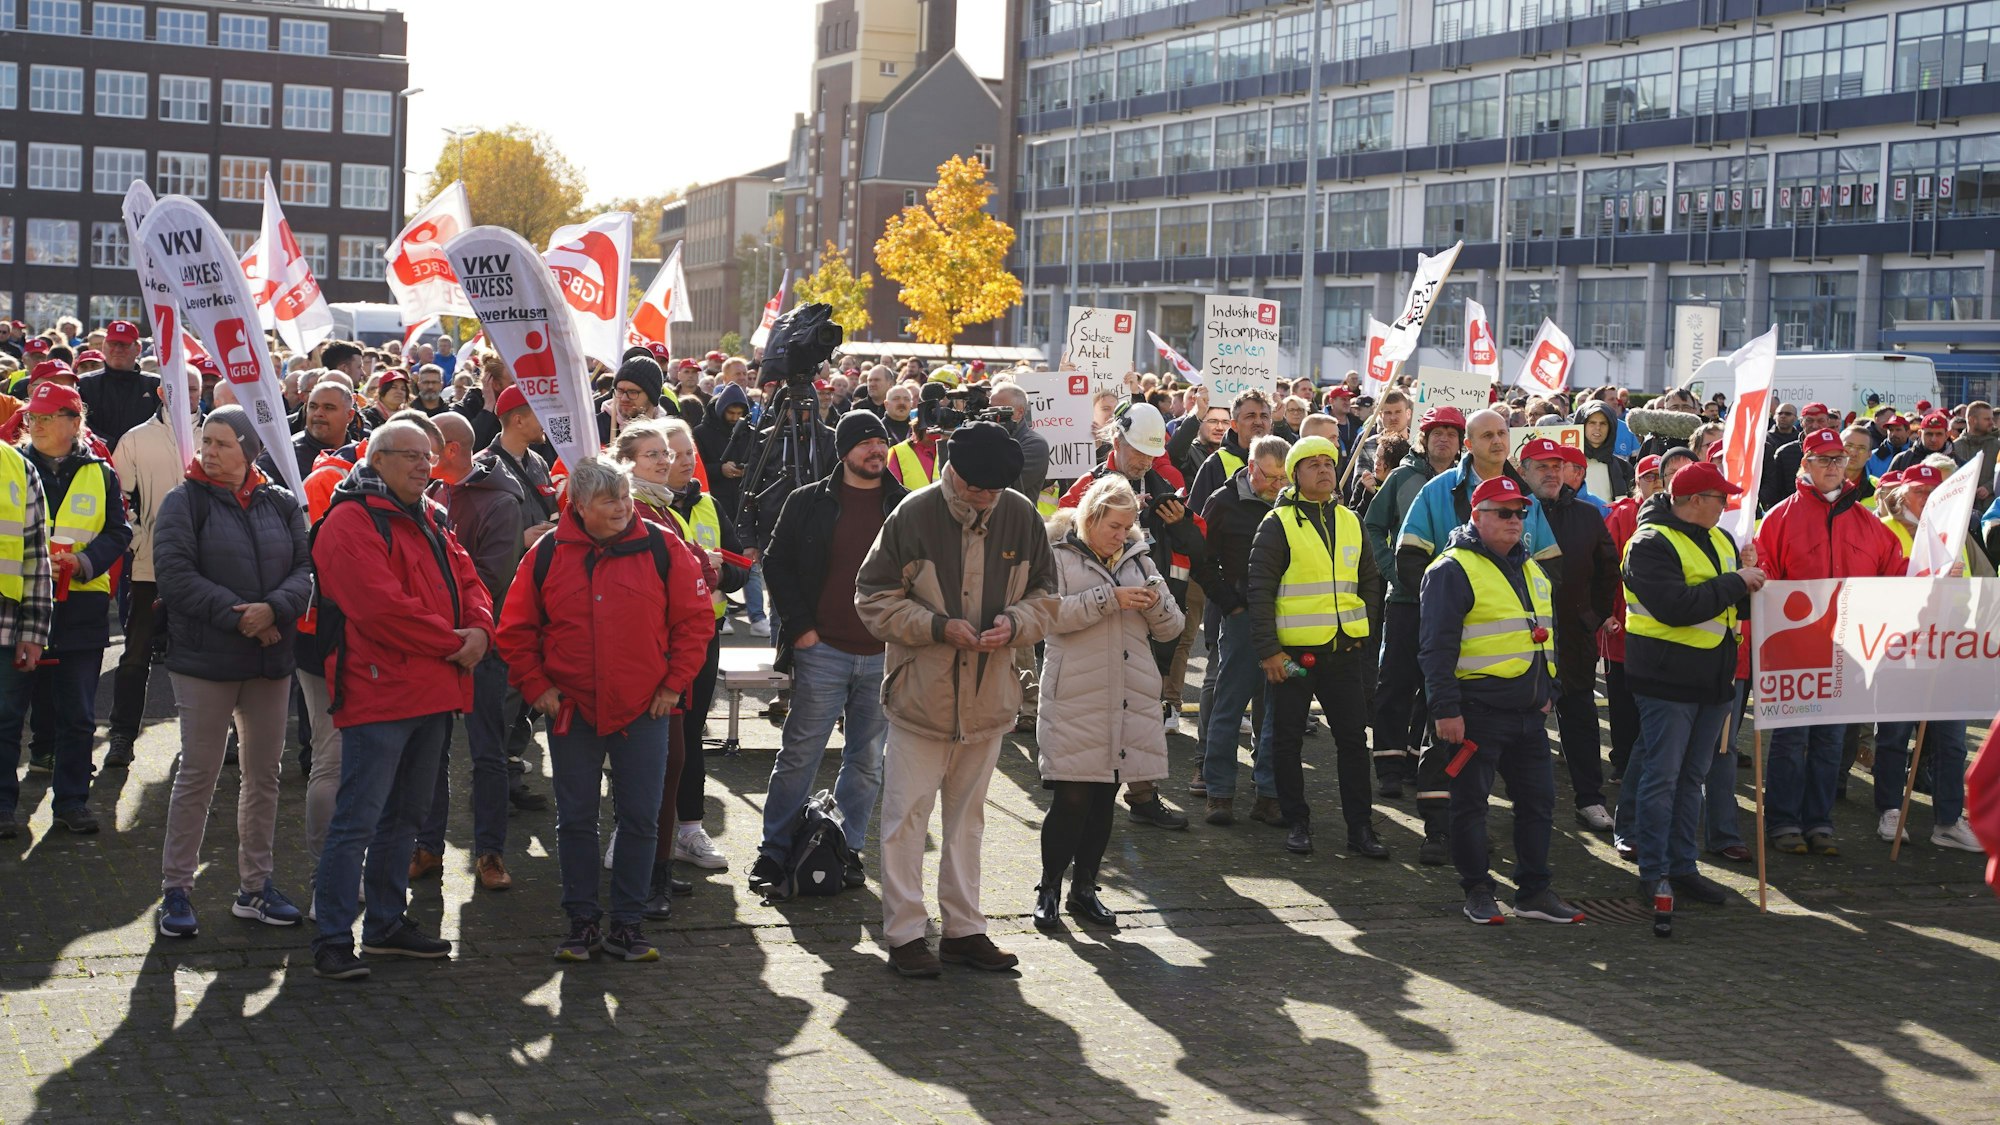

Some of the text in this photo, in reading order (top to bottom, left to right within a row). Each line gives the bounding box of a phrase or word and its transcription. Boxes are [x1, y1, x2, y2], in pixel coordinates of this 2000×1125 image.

[158, 228, 203, 256] VKV
[462, 254, 511, 275] VKV
[465, 276, 513, 298] ANXESS
[479, 306, 548, 323] everkusen
[1212, 303, 1258, 320] Industrie
[1080, 326, 1114, 343] Sichere
[1207, 321, 1278, 342] Strompreise
[1078, 344, 1111, 359] Arbeit
[1217, 342, 1265, 357] senken
[1210, 357, 1270, 380] Standorte
[1780, 387, 1814, 401] media
[1897, 391, 1927, 405] media
[1832, 584, 1853, 698] Standort Leverkusen
[1760, 703, 1822, 716] VKV Covestro
